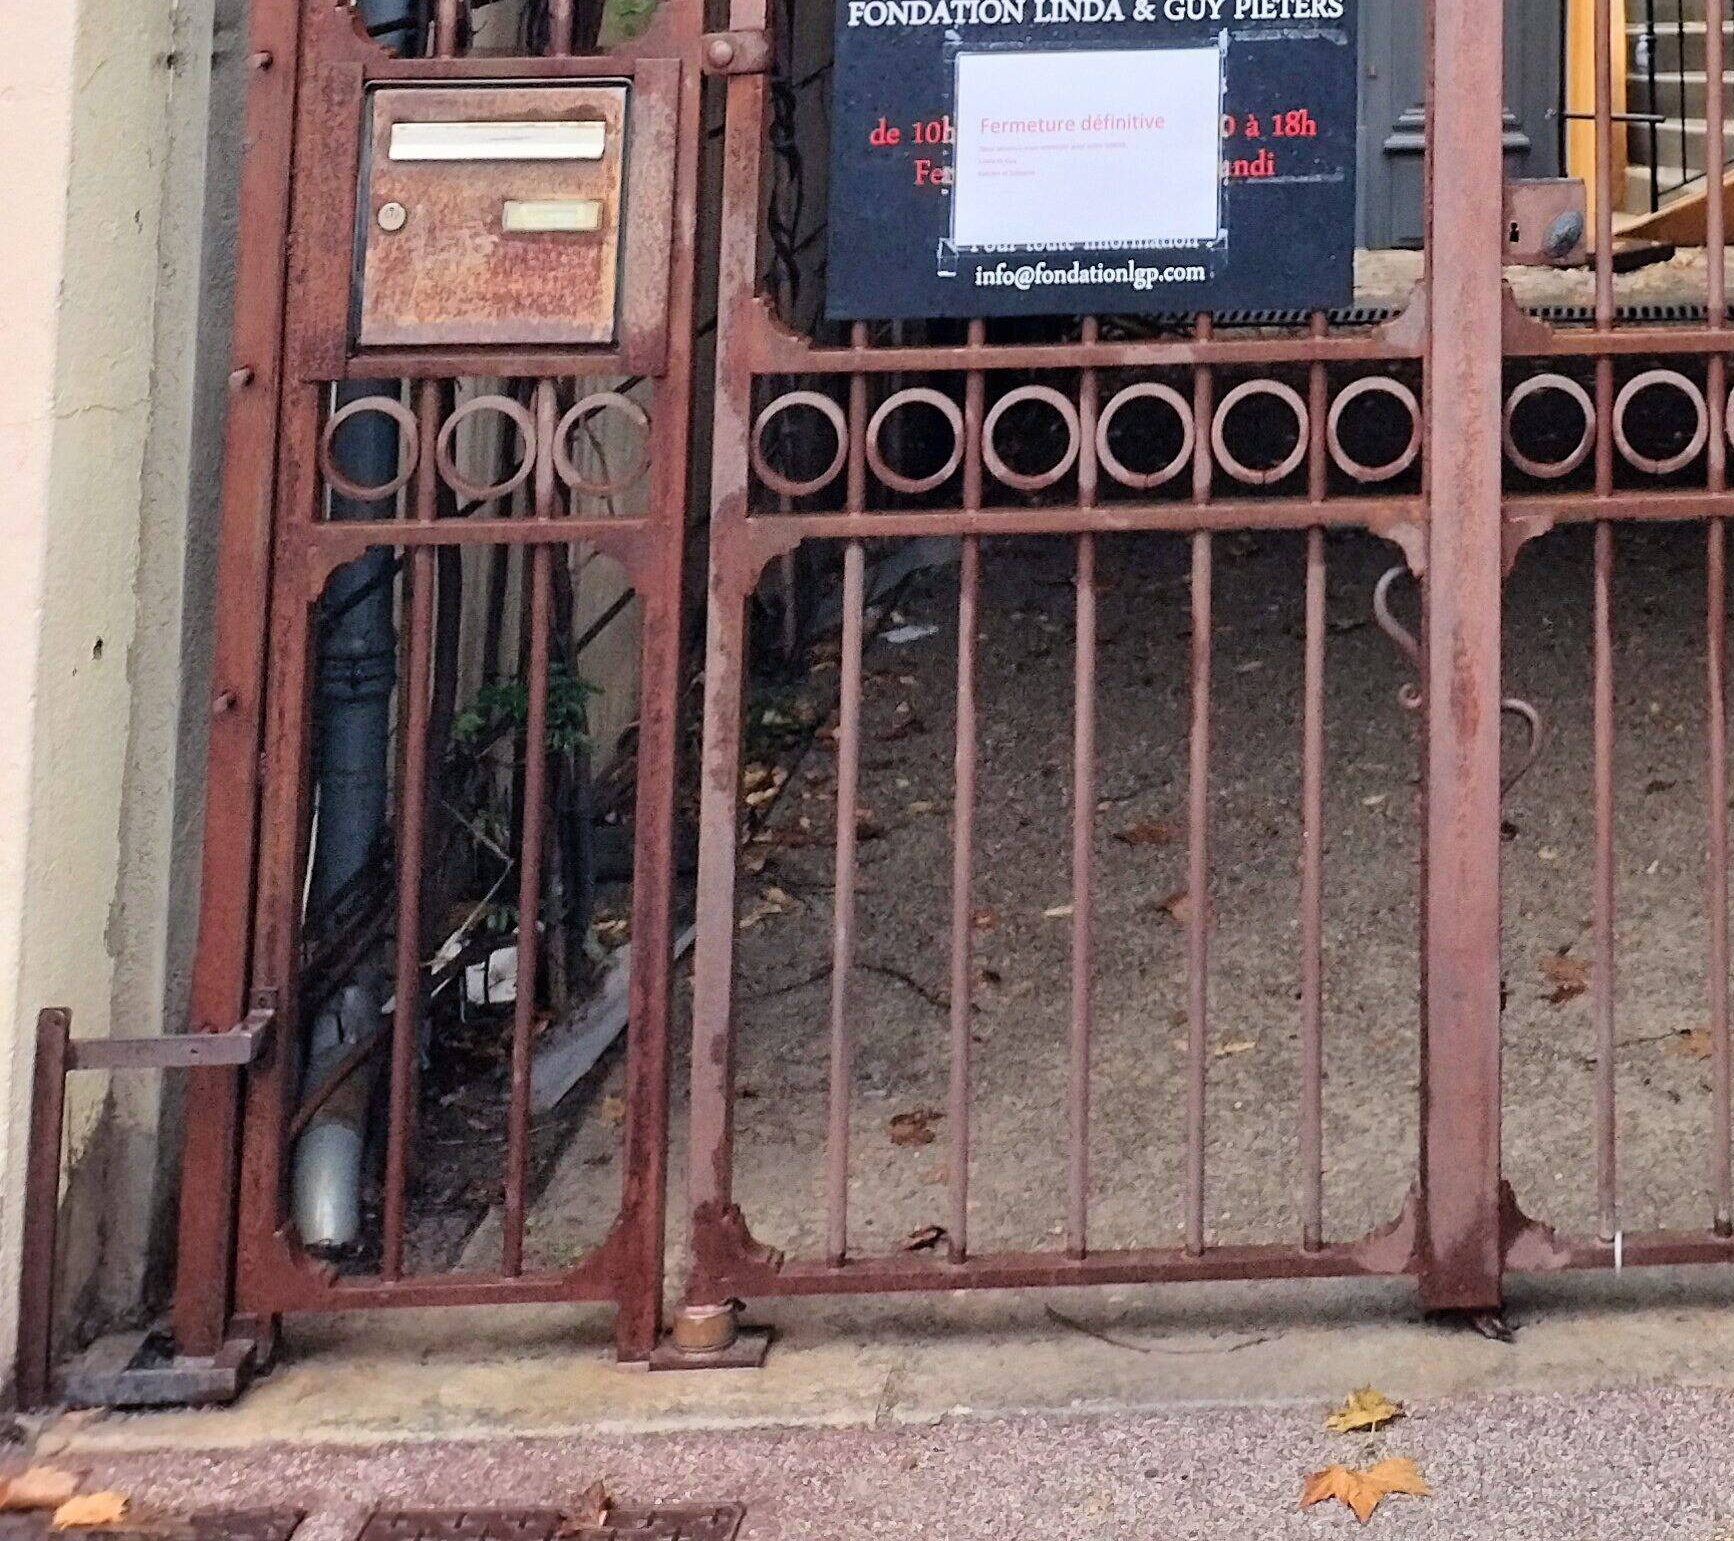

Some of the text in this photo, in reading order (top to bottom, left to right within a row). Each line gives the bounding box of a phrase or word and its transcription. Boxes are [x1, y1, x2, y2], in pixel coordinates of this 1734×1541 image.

[869, 117, 901, 146] de
[1244, 113, 1260, 139] à
[1272, 108, 1317, 137] 18h
[980, 113, 1165, 134] Fermeture définitive
[975, 260, 1206, 290] info@fondationlgp.com
